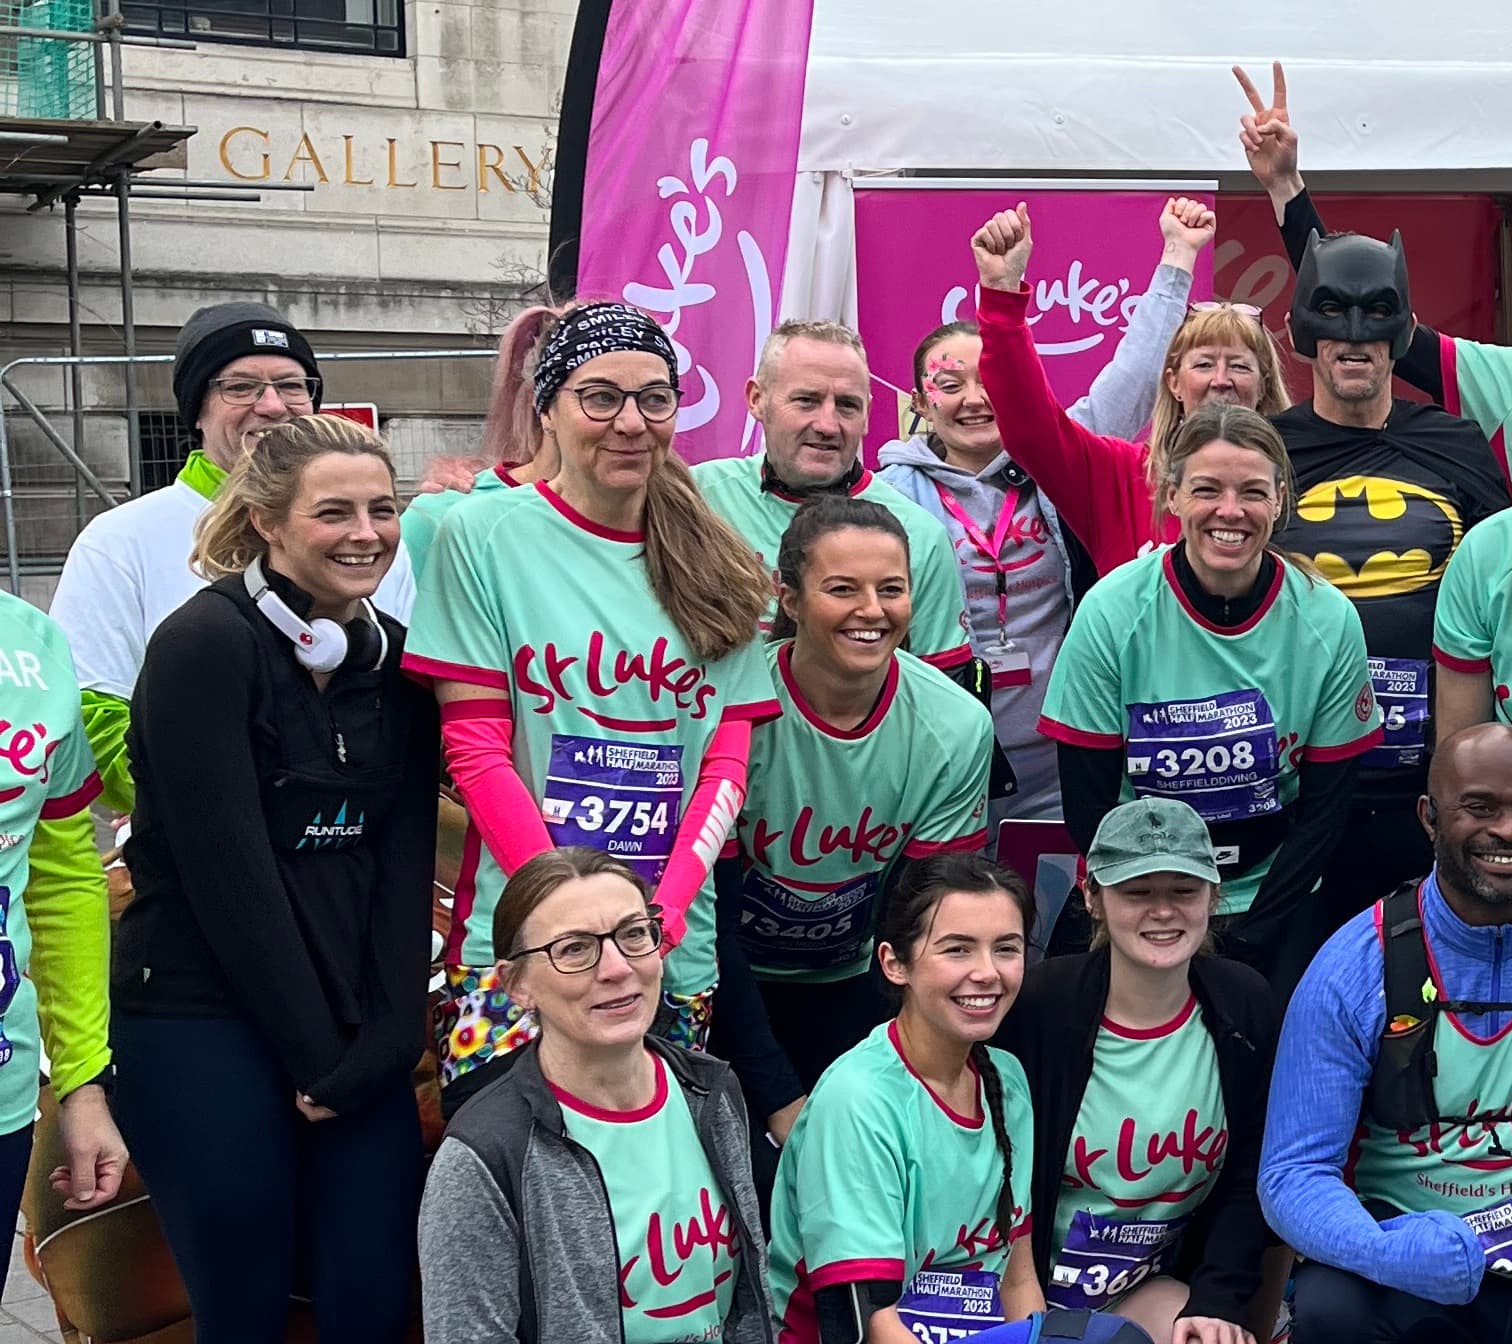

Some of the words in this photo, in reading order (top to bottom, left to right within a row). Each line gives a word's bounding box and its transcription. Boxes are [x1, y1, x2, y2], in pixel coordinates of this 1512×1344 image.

[218, 126, 552, 194] GALLERY
[586, 630, 717, 721] Luke's
[1387, 681, 1416, 693] 2023
[1168, 700, 1217, 716] SHEFFIELD
[1197, 703, 1255, 723] MARATHON
[1223, 715, 1258, 729] 2023
[607, 747, 657, 761] SHEFFIELD
[1156, 741, 1255, 778] 3208
[634, 761, 680, 772] MARATHON
[656, 773, 679, 785] 2023
[1156, 771, 1258, 790] SHEFFIELDDIVING
[575, 795, 668, 837] 3754
[607, 840, 643, 852] DAWN
[755, 913, 853, 940] 3405
[1417, 1172, 1496, 1199] Sheffield's
[1118, 1234, 1143, 1244] HALF
[916, 1273, 962, 1285] SHEFFIELD
[916, 1283, 939, 1295] HALF
[940, 1284, 992, 1299] MARATHON
[963, 1299, 992, 1313] 2023
